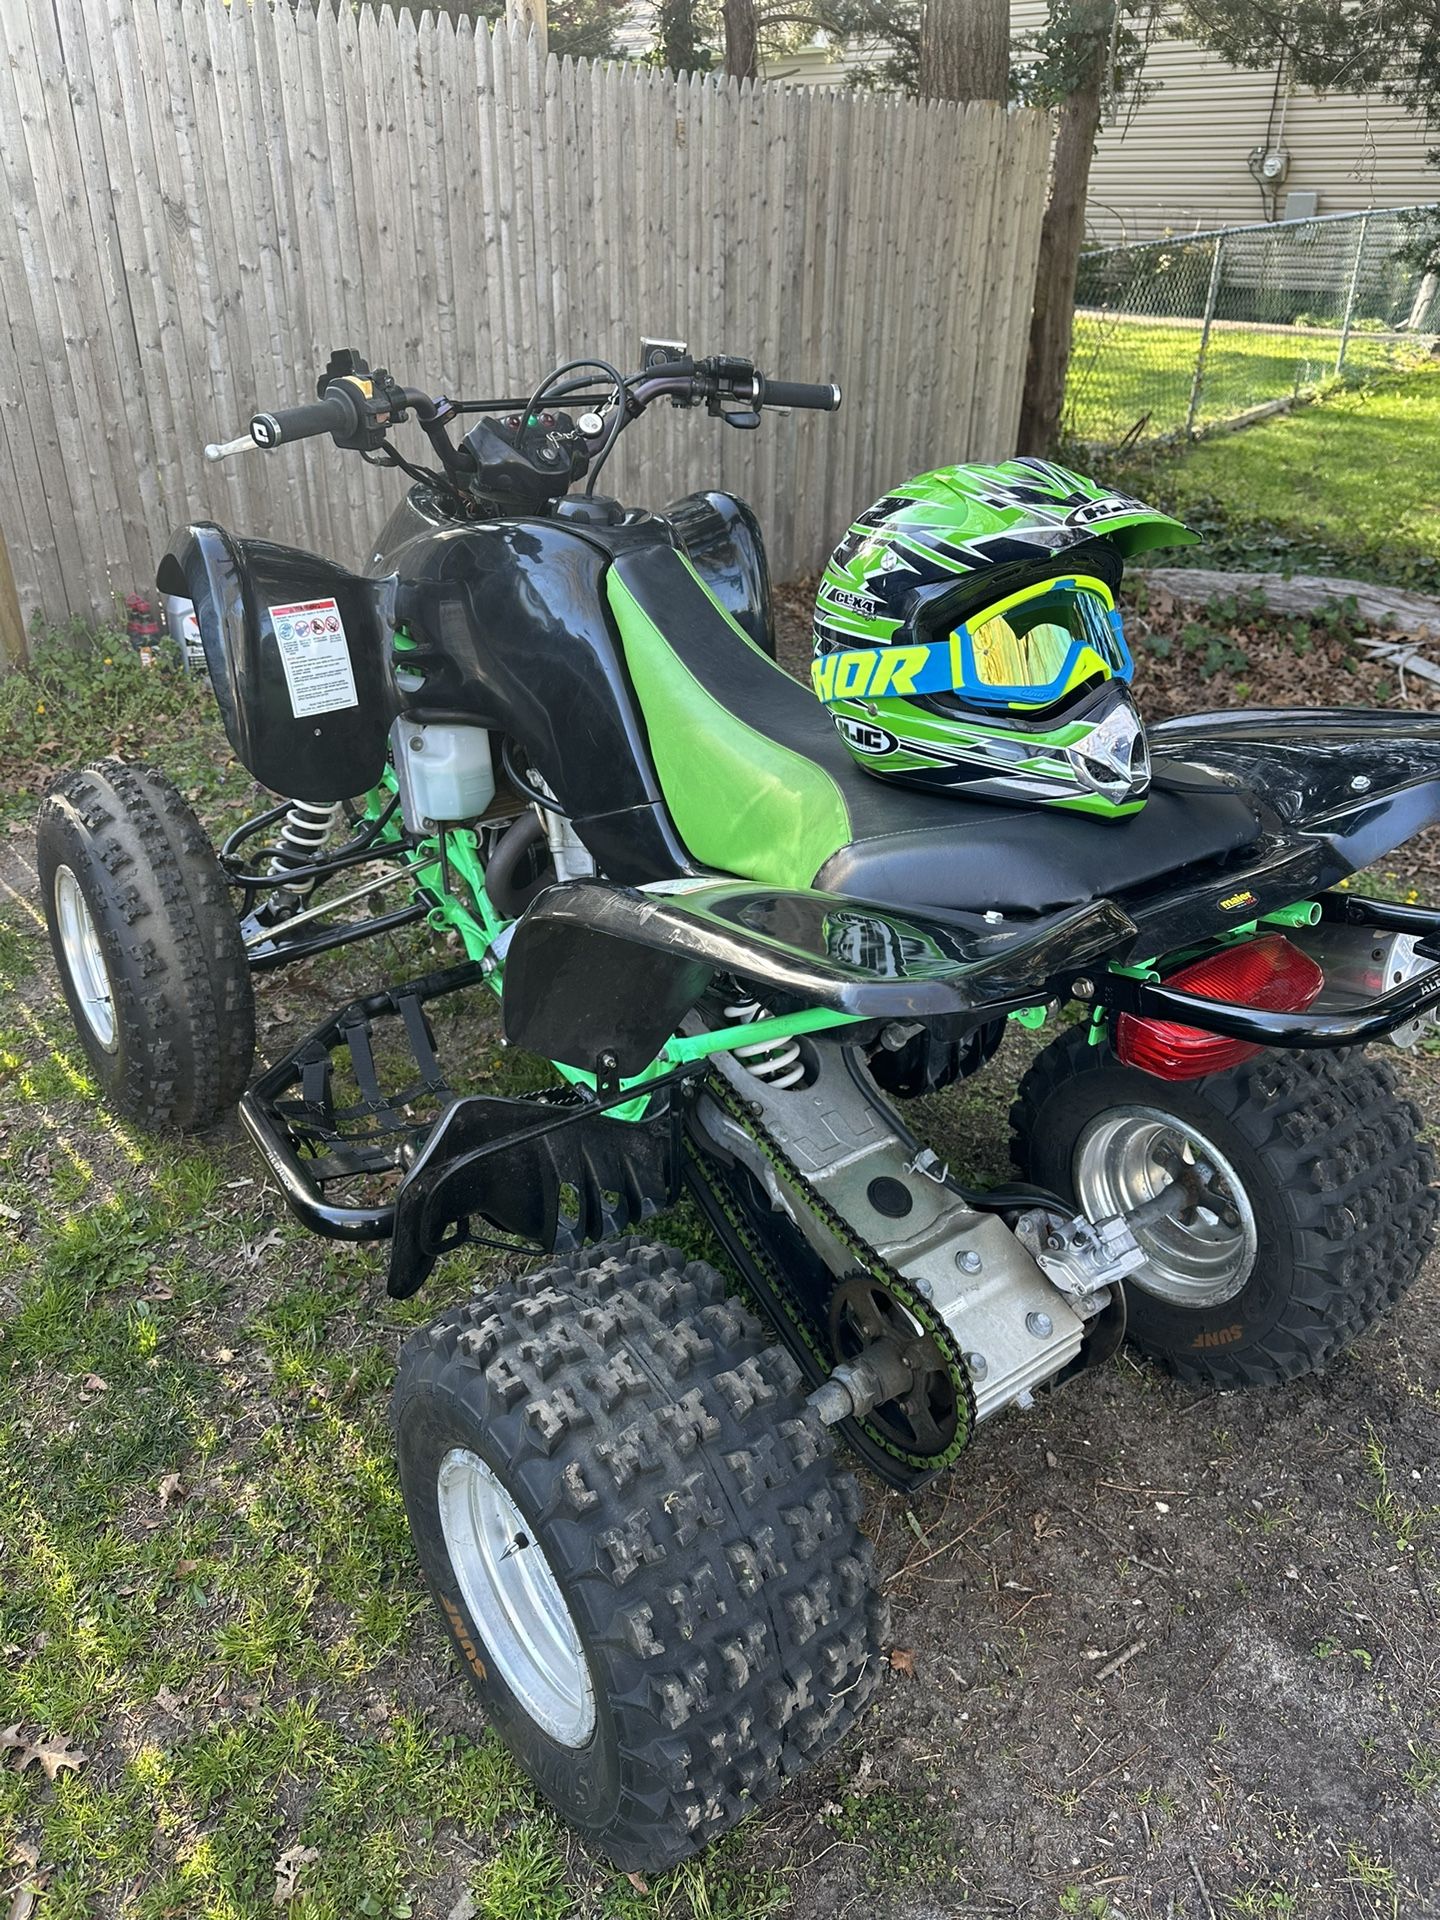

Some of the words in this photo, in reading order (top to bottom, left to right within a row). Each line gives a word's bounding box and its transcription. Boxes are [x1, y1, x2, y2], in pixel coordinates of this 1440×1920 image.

[811, 646, 931, 703] HOR
[838, 719, 882, 749] HJC
[1220, 891, 1252, 909] maier
[1190, 1324, 1243, 1348] SUNF
[439, 1592, 488, 1681] SUNF
